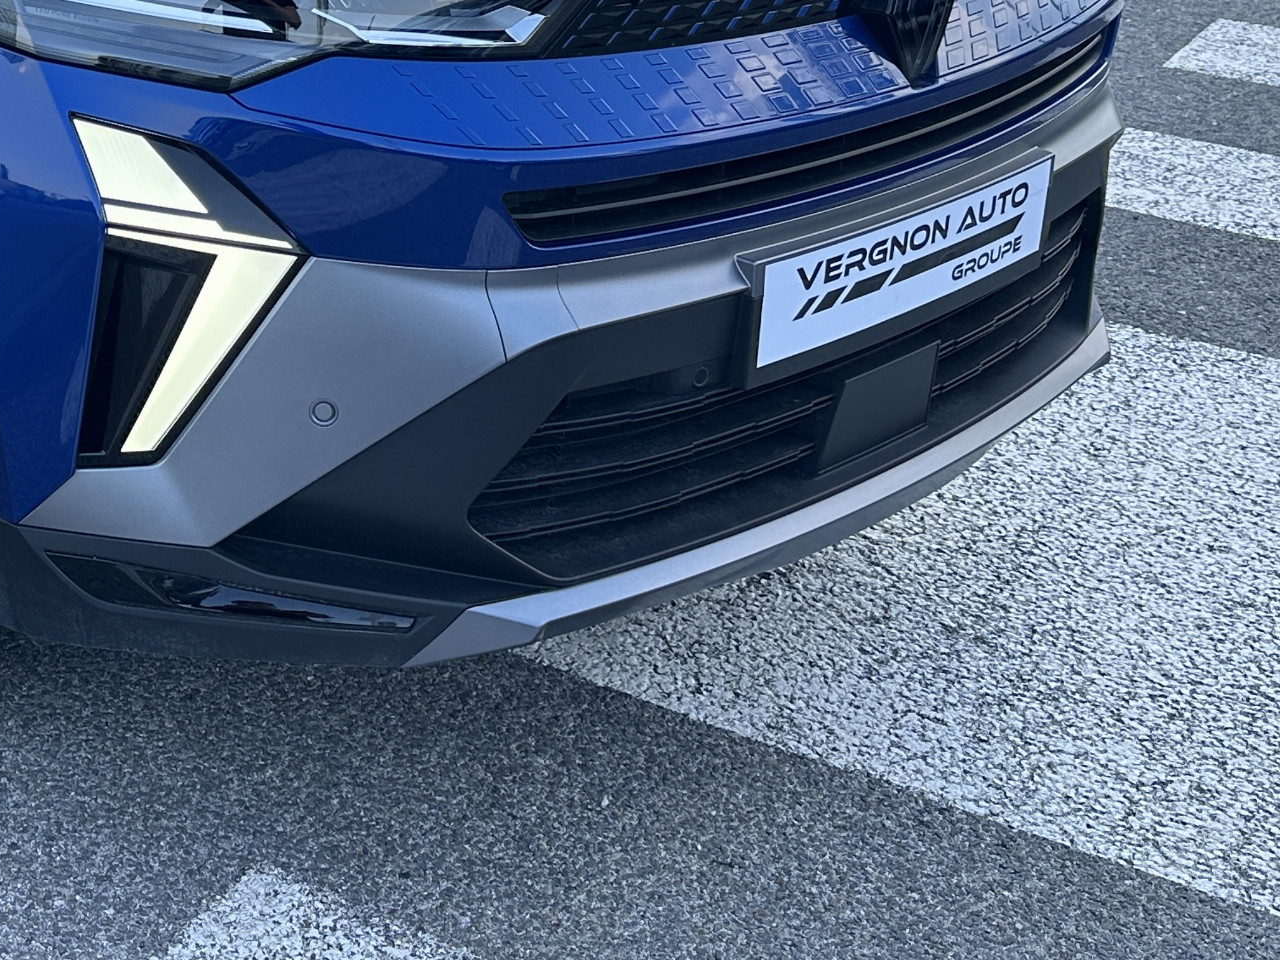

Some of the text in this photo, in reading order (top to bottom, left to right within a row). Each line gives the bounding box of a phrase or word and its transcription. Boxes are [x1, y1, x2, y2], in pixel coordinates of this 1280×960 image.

[796, 181, 1029, 291] VERGNON AUTO
[951, 234, 1023, 282] GROUPE
